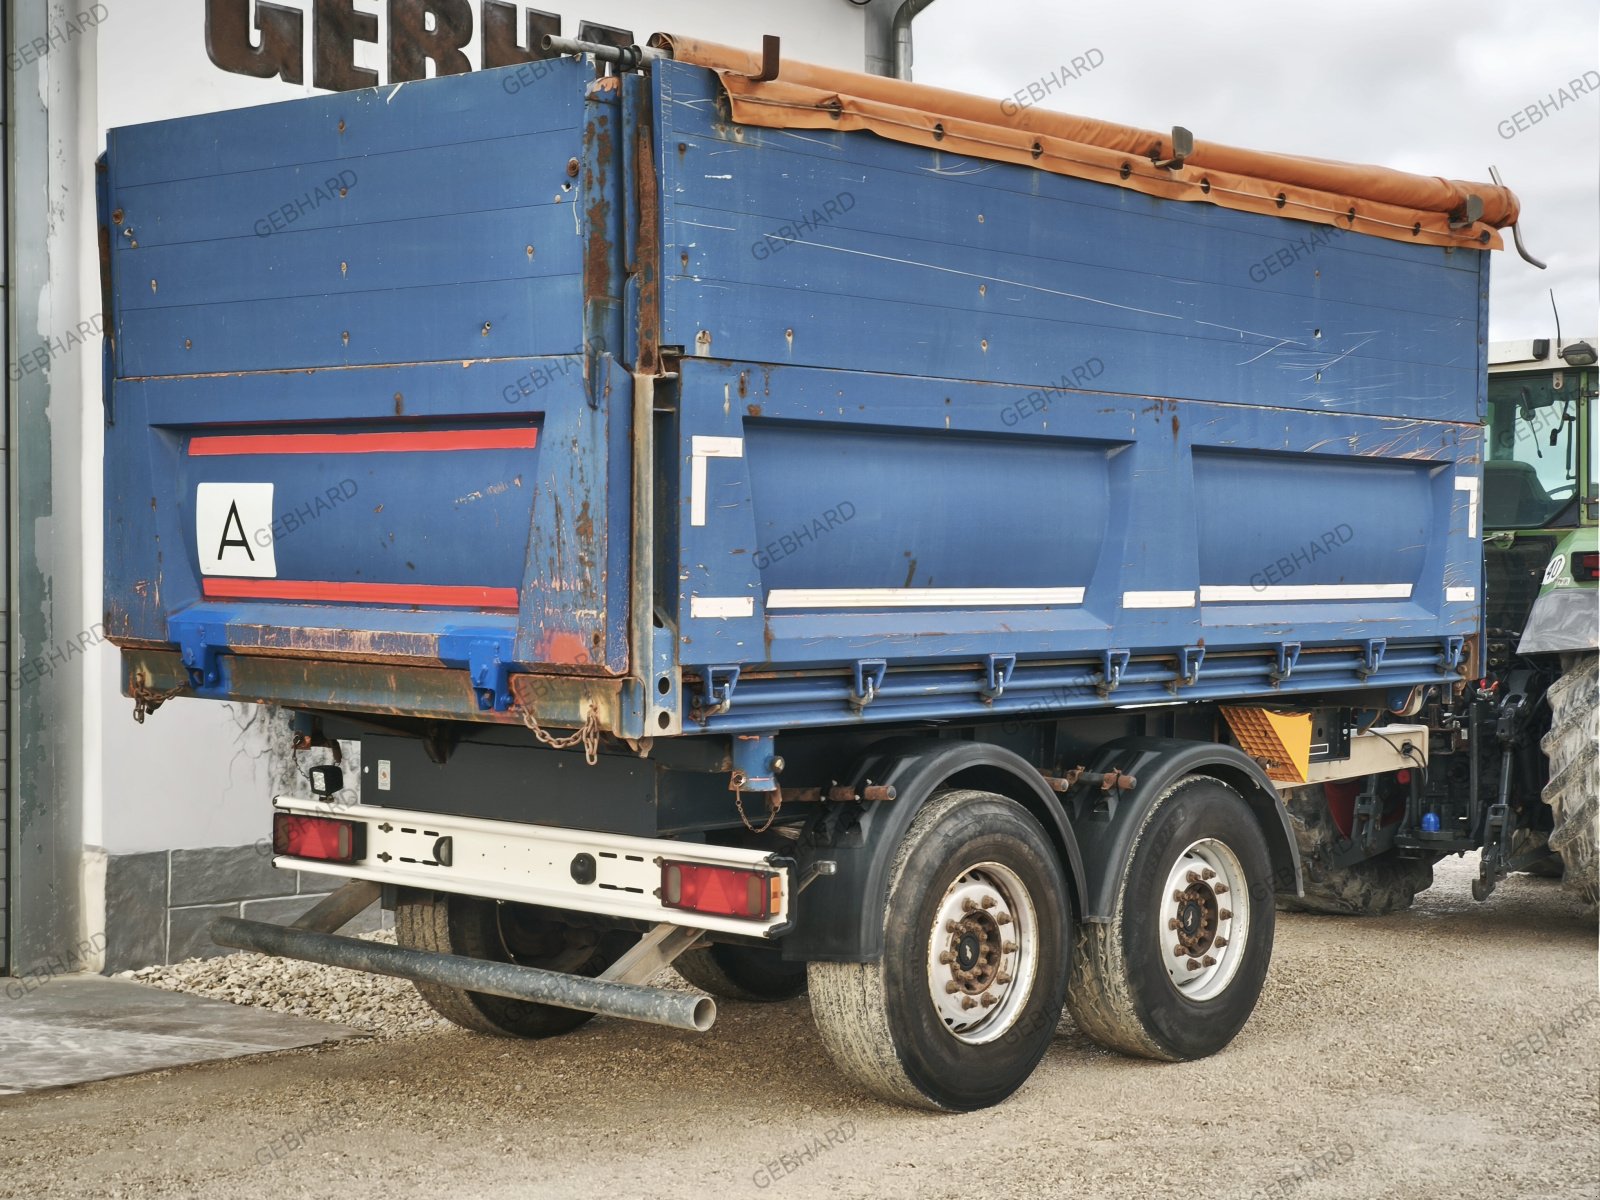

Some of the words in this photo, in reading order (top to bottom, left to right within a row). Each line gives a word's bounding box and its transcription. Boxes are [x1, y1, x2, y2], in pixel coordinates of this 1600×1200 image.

[205, 0, 634, 92] GEBH
[218, 499, 255, 562] A
[1546, 557, 1563, 581] 40
